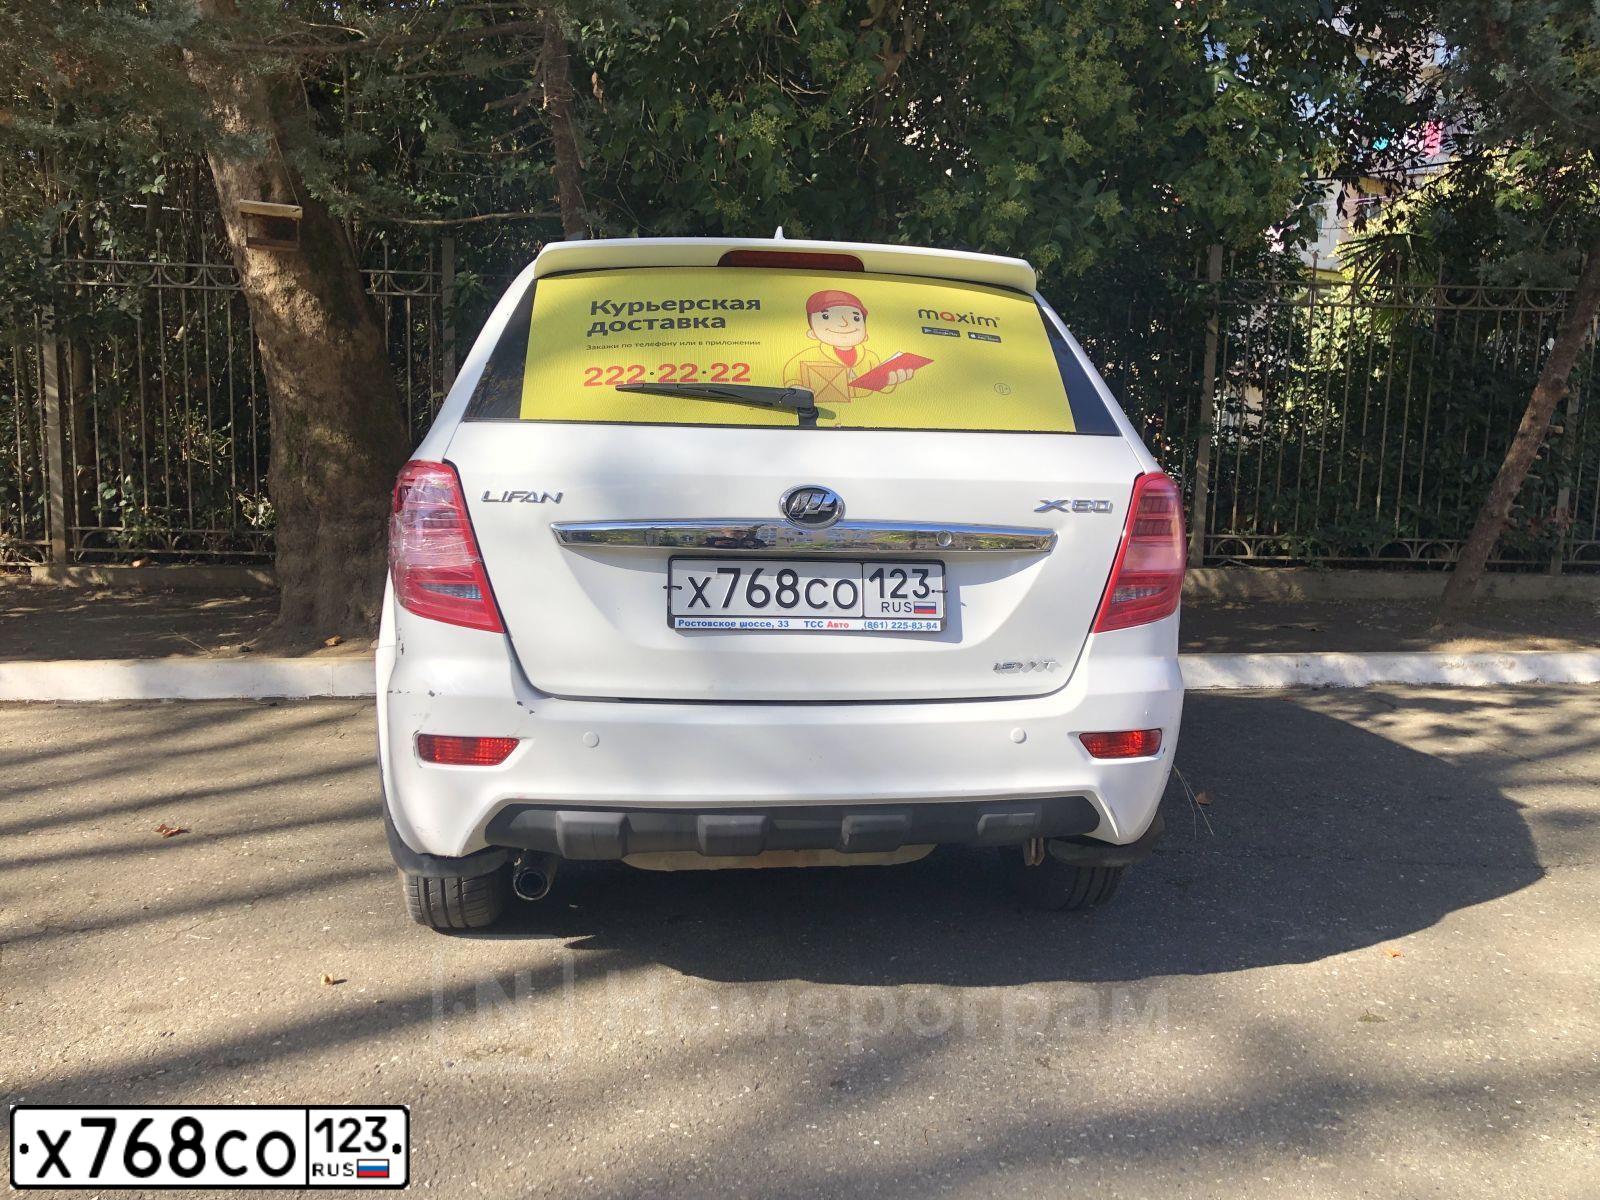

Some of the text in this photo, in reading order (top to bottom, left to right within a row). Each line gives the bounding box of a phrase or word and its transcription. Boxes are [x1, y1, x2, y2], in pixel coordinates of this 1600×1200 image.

[590, 299, 761, 317] Курьерская
[918, 308, 998, 328] maxim
[586, 316, 726, 337] доставка
[481, 490, 564, 504] LIFAN
[1033, 499, 1113, 514] X60
[868, 567, 930, 599] 123
[881, 601, 912, 613] RUS
[678, 619, 938, 630] Ростовское шоссе, 33 ТСС Авто (861) 225-83-84
